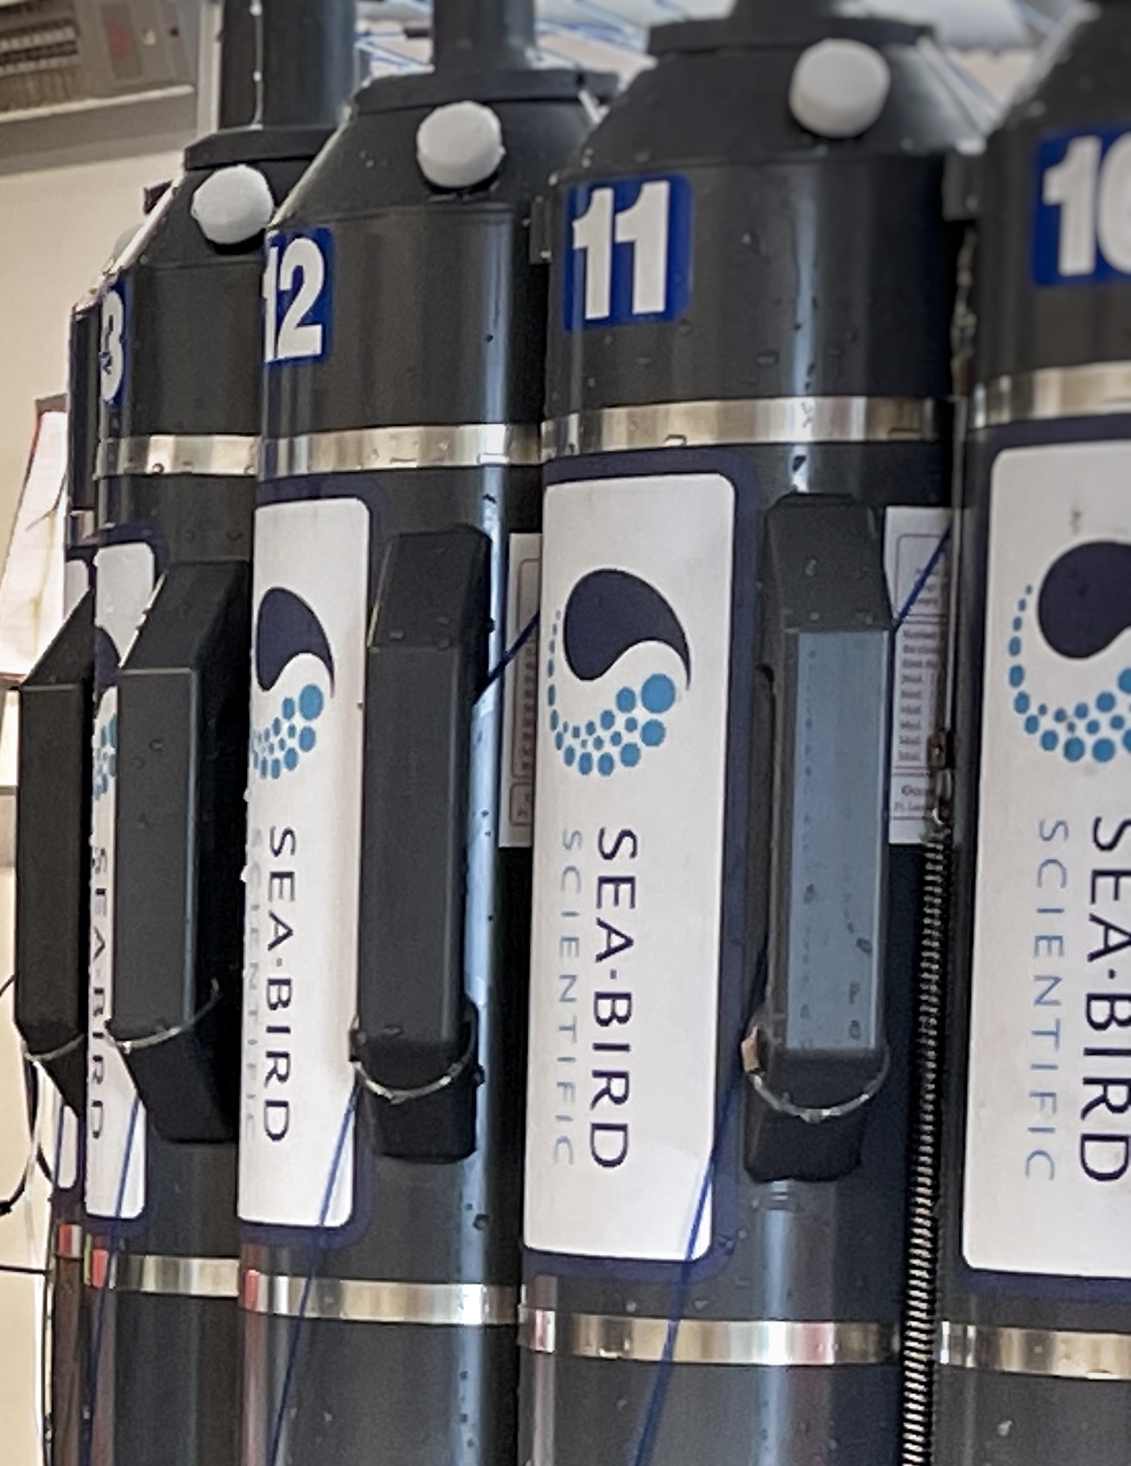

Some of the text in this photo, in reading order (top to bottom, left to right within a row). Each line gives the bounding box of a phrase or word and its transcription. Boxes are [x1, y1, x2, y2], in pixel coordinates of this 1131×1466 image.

[262, 238, 324, 363] 12
[573, 181, 669, 320] 11
[553, 828, 582, 1165] SCIENTIFIC
[1024, 819, 1069, 1180] SCIENTIFIC
